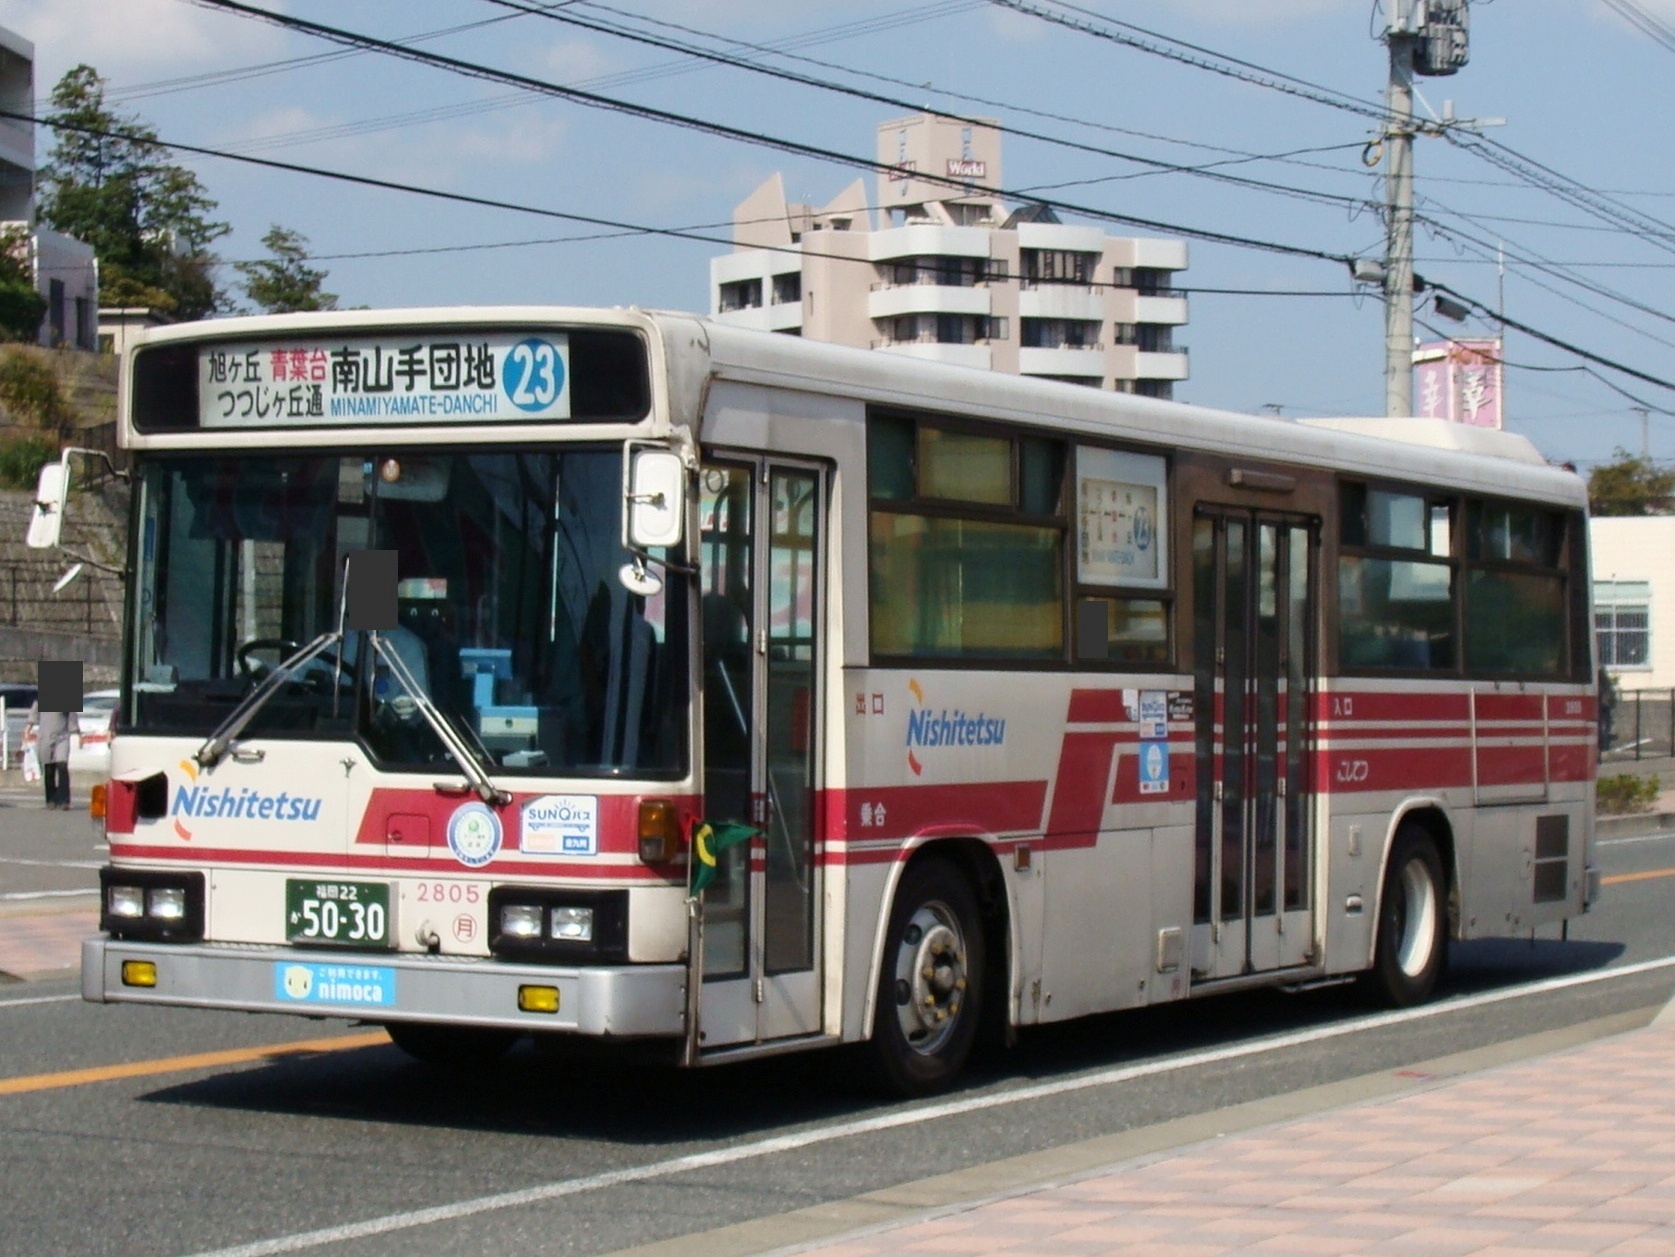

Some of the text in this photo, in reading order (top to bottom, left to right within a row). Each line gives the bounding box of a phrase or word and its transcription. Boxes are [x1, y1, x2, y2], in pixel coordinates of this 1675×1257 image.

[949, 162, 984, 176] World
[270, 348, 328, 382] 青葉台
[330, 343, 496, 394] 南山手団地
[512, 344, 555, 405] 23
[856, 693, 884, 715] 出口
[1334, 697, 1352, 715] 入口
[906, 709, 1005, 746] Nishitetsu
[171, 785, 322, 821] Nishitetsu
[417, 883, 479, 903] 2805
[303, 900, 385, 940] 50-30
[319, 978, 383, 1002] nimoca
